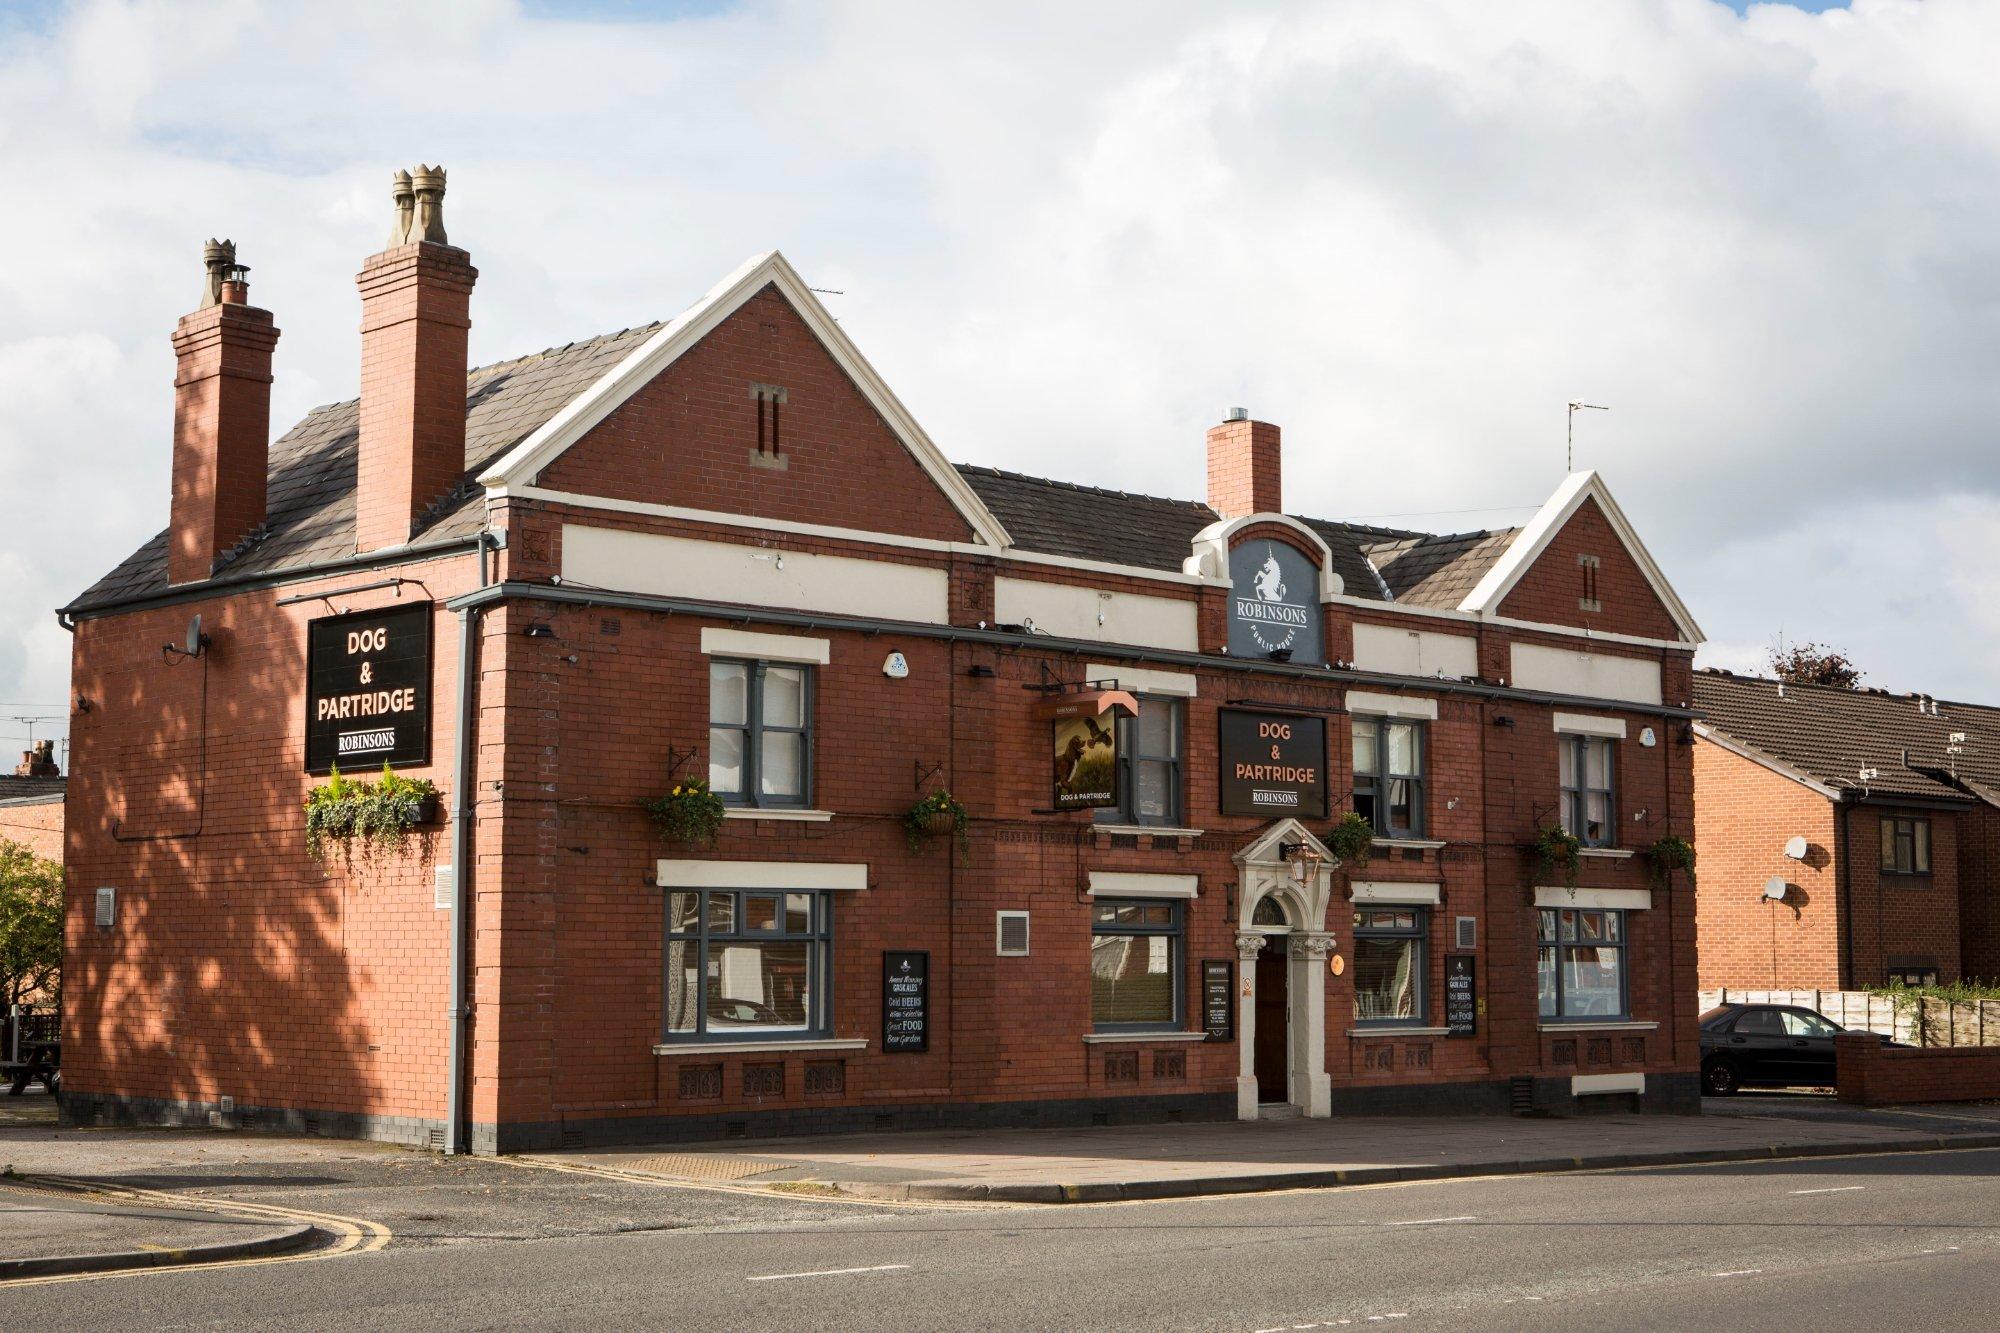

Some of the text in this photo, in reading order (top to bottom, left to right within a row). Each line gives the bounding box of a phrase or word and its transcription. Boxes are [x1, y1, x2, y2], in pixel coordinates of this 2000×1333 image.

[1237, 601, 1307, 624] ROBINSONS
[347, 627, 388, 655] DOG
[1250, 624, 1296, 652] PUBLIC HOUSE
[359, 661, 373, 685] &
[318, 688, 415, 721] PARTRIDGE
[1259, 722, 1291, 740] DOG
[338, 731, 395, 751] ROBINSONS
[1271, 744, 1280, 760] &
[1236, 763, 1315, 784] PARTRIDGE
[1079, 792, 1111, 800] PARTRIDGE
[1252, 791, 1298, 804] ROBINSONS
[906, 984, 918, 992] ALES
[902, 997, 921, 1006] BEERS
[903, 1021, 922, 1030] FOOD
